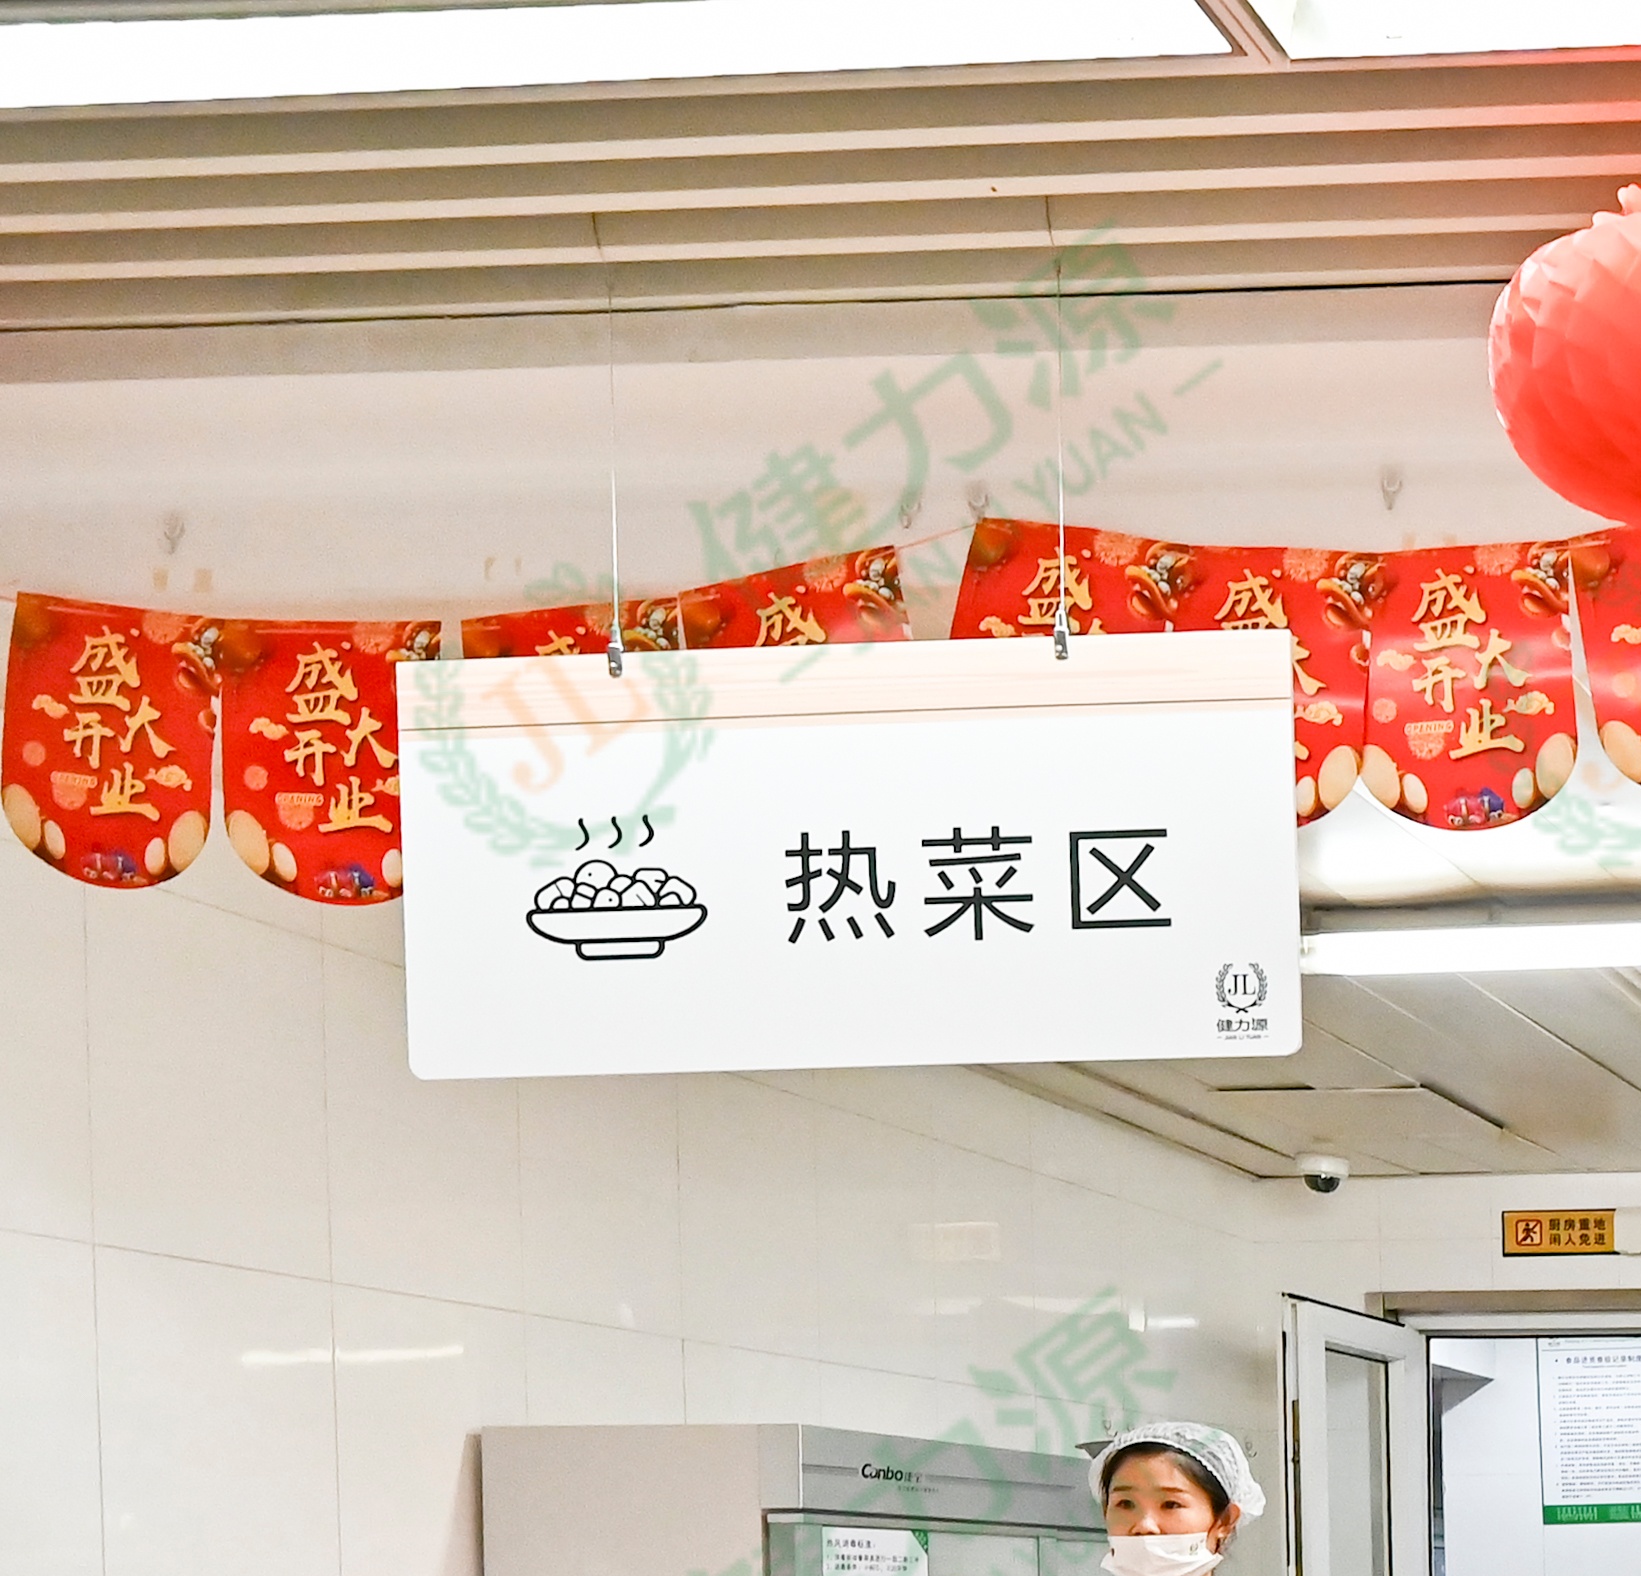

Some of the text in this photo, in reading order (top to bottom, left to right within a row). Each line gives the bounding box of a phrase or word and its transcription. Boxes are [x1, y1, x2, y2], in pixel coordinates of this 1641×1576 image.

[785, 826, 1172, 944] 热菜区
[1548, 1218, 1606, 1231] 厨房重地
[1549, 1233, 1606, 1246] 闲人免进
